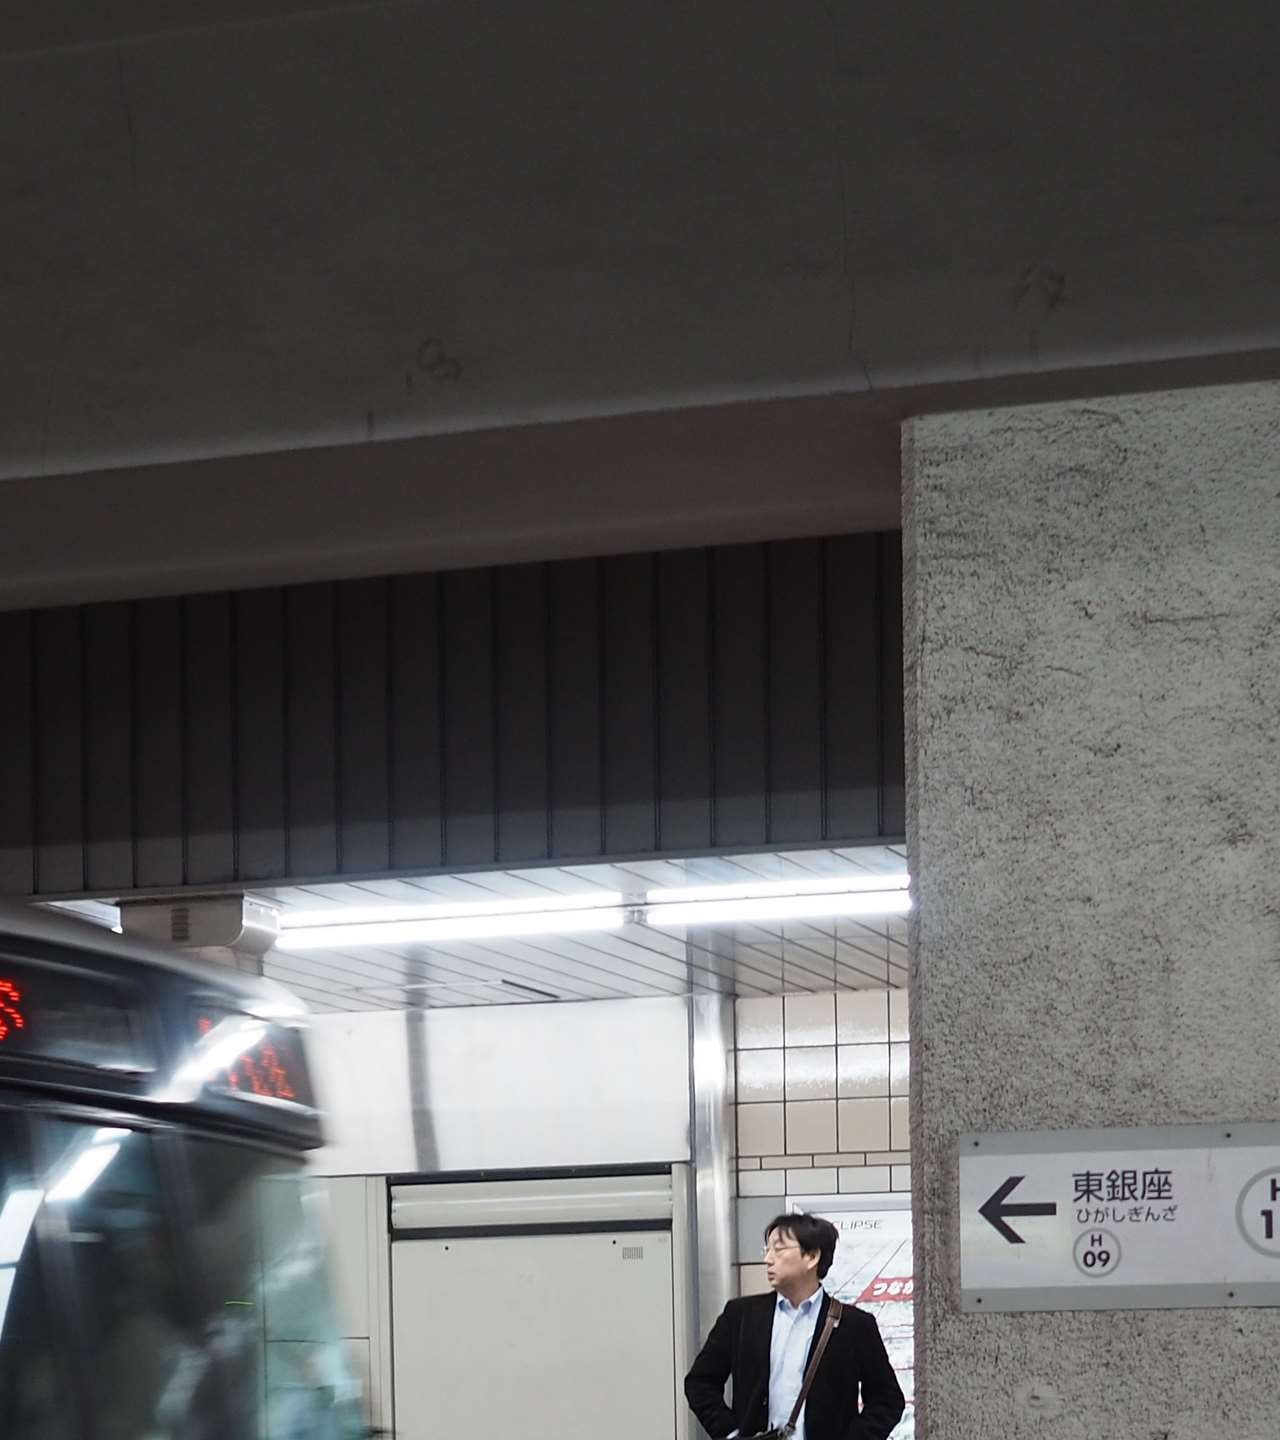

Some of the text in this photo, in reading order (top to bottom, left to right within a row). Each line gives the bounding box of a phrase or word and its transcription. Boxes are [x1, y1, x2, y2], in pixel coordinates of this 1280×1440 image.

[1072, 1168, 1173, 1203] 東銀座
[1076, 1204, 1178, 1223] ひがしぎんざ
[835, 1220, 883, 1230] LIPSE
[1090, 1233, 1103, 1247] H
[1083, 1250, 1111, 1268] 09
